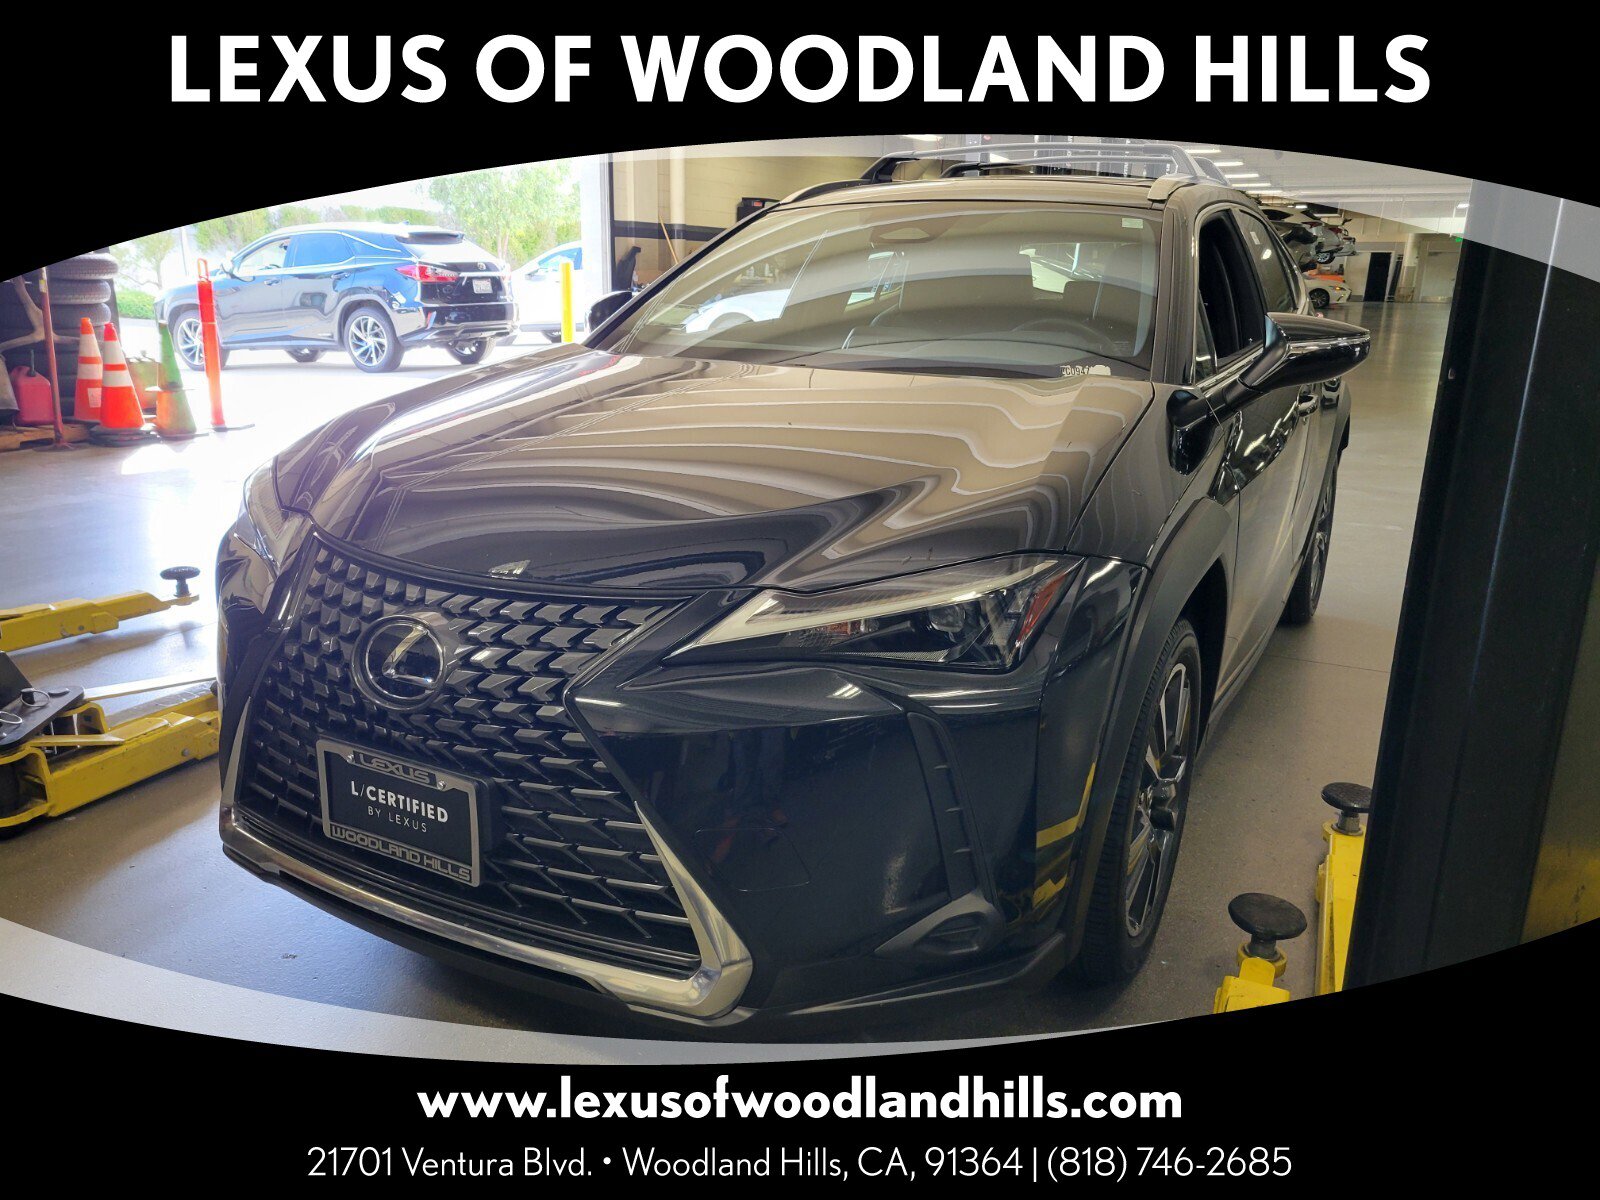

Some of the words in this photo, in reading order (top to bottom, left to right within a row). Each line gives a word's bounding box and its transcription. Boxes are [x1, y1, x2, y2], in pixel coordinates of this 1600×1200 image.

[359, 753, 431, 785] LEXUS
[350, 780, 449, 824] L/CERTIFIED
[367, 805, 382, 818] BY
[388, 812, 427, 833] LEXUS
[331, 825, 421, 864] WOODLAND
[423, 854, 471, 881] HILLS
